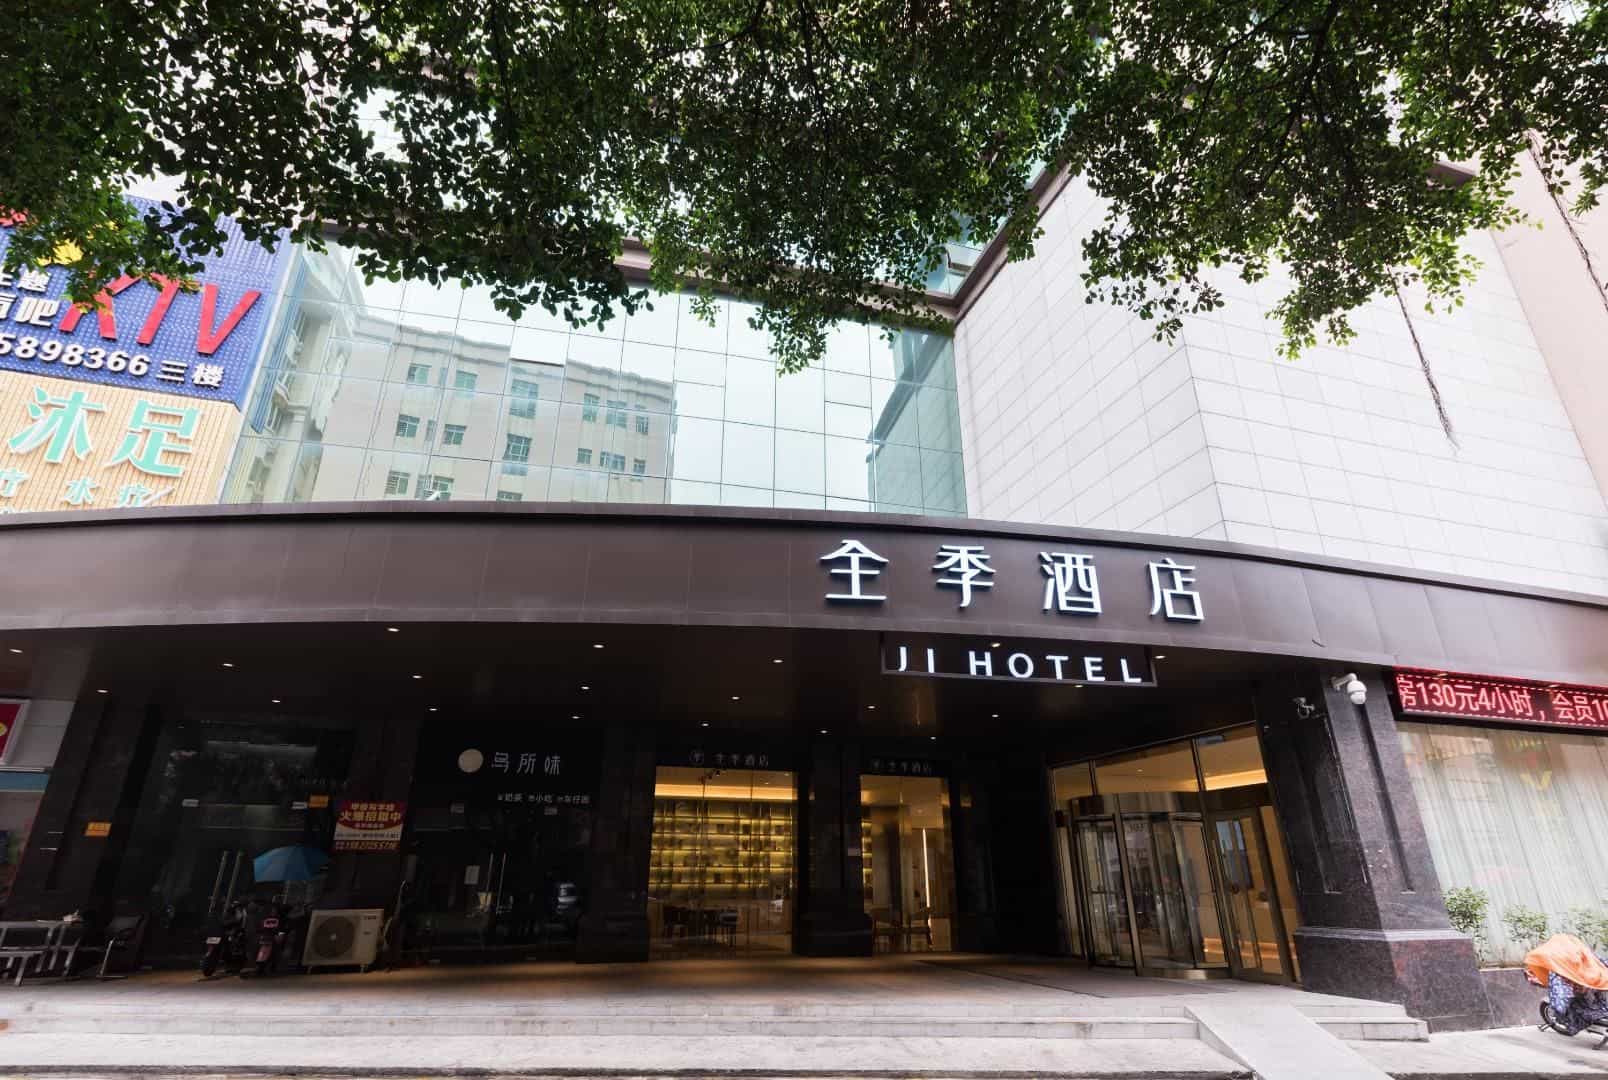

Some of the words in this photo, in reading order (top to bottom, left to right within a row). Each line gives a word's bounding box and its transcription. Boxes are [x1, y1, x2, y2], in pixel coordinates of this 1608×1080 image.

[59, 271, 262, 355] KTV
[156, 360, 225, 389] 三楼
[7, 385, 203, 478] 沐足
[820, 539, 1205, 622] 全季酒店
[898, 646, 935, 674] JI
[967, 650, 1143, 684] HOTEL
